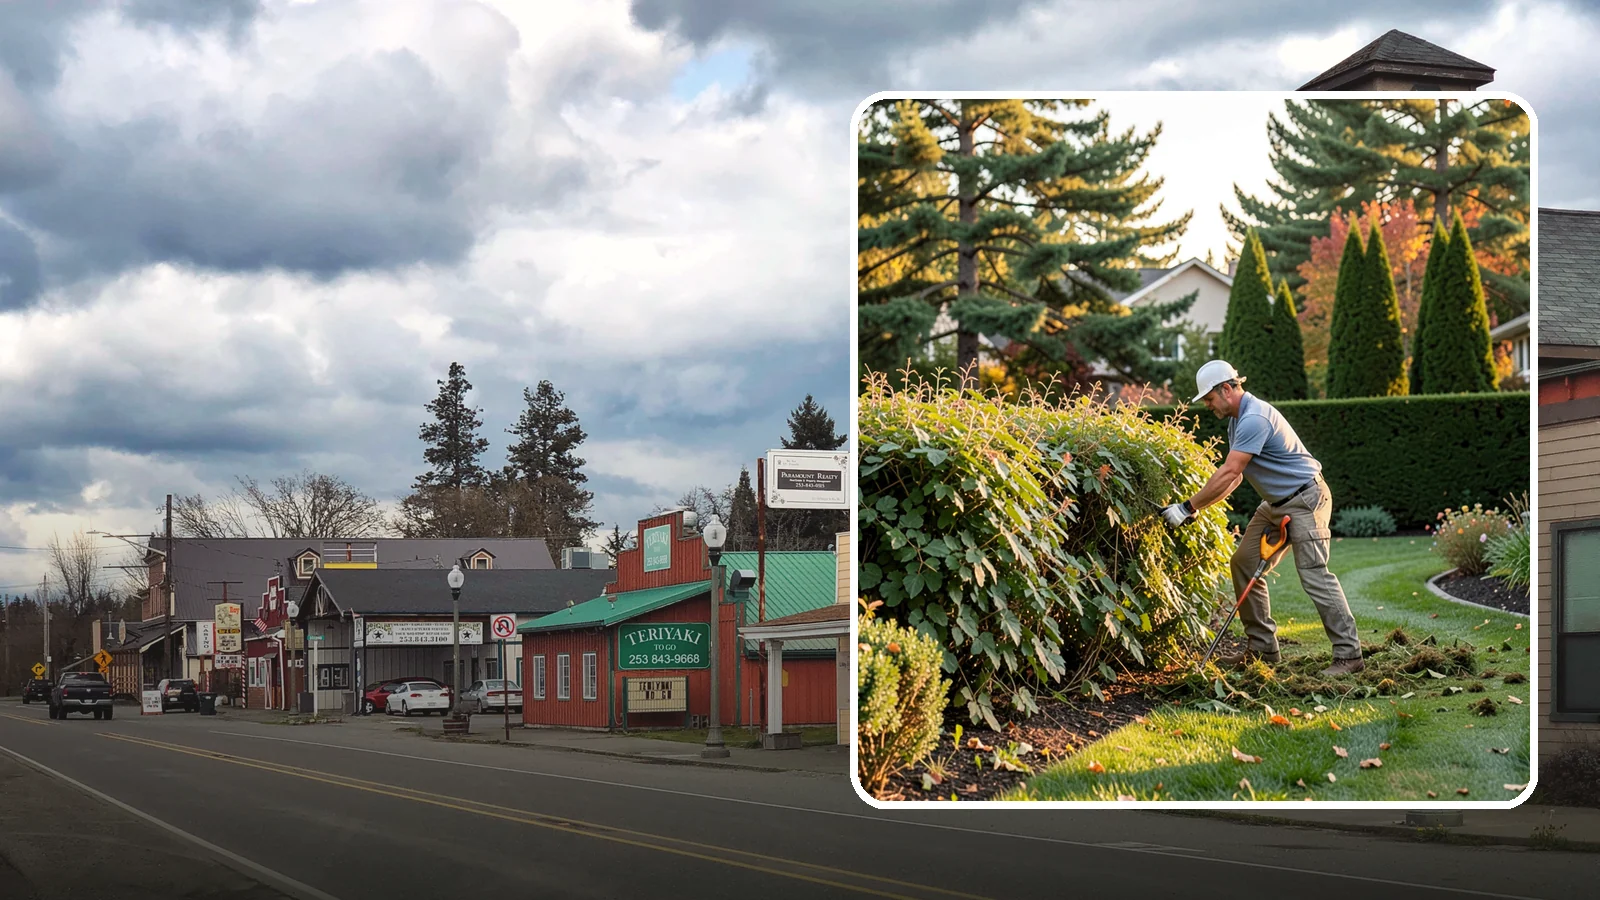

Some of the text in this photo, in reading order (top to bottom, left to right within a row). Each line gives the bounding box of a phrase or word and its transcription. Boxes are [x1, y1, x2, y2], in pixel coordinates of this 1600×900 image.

[625, 628, 702, 646] TERIYAKI
[629, 654, 700, 664] 253 843-9668
